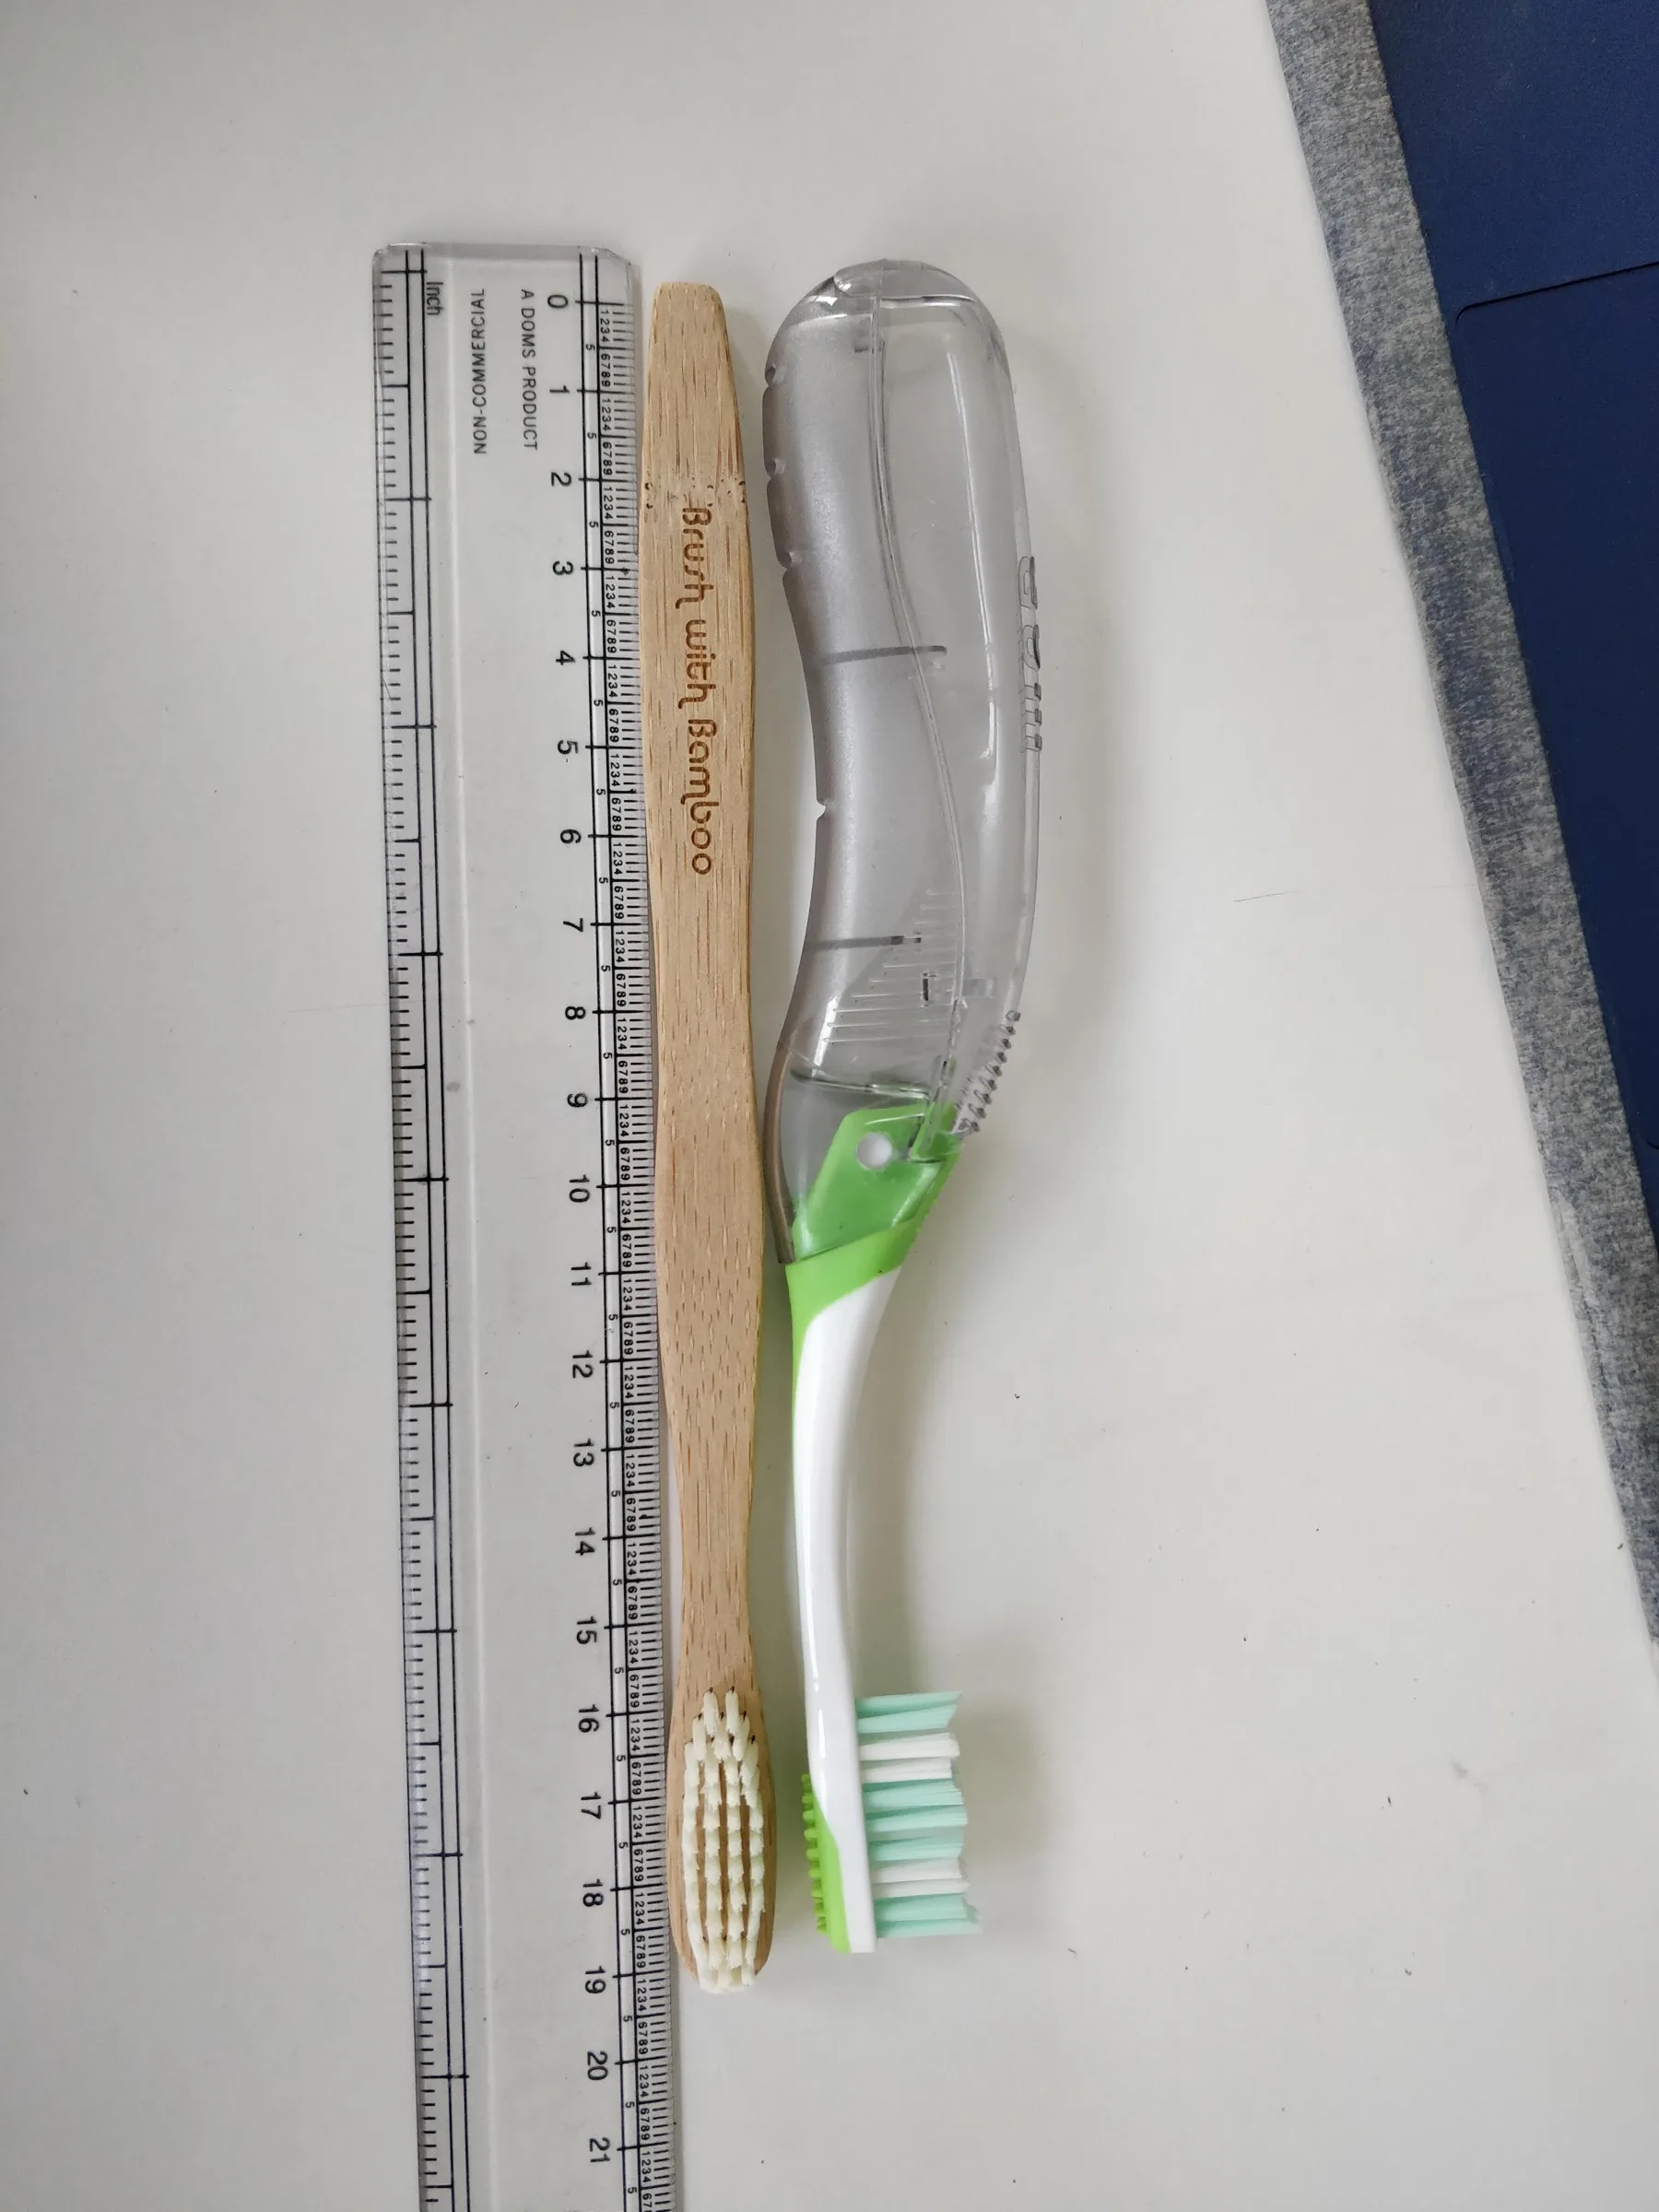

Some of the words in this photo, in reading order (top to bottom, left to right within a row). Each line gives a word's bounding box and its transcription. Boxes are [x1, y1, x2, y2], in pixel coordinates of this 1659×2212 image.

[426, 281, 444, 316] Inch
[520, 288, 535, 300] A
[547, 294, 569, 309] 0
[520, 307, 536, 359] DOMS
[471, 288, 488, 454] NON-COMMERCIAL
[549, 385, 571, 394] 1
[522, 366, 538, 451] PRODUCT
[551, 472, 572, 487] 2
[552, 560, 574, 575] 3
[675, 508, 715, 610] Brush
[555, 650, 576, 665] 4
[677, 618, 717, 710] with
[558, 740, 579, 755] 5
[681, 719, 720, 876] Bamboo
[560, 829, 582, 844] 6
[562, 917, 583, 933] 7
[565, 1006, 586, 1020] 8
[567, 1093, 588, 1108] 9
[569, 1174, 590, 1203] 10
[571, 1262, 592, 1287] 11
[572, 1349, 594, 1379] 12
[573, 1438, 594, 1467] 13
[574, 1527, 595, 1556] 14
[576, 1616, 597, 1644] 15
[578, 1704, 600, 1733] 16
[581, 1792, 602, 1819] 17
[582, 1878, 604, 1907] 18
[584, 1965, 606, 1994] 19
[587, 2051, 608, 2080] 20
[589, 2137, 611, 2163] 21
[642, 2193, 653, 2212] 67
